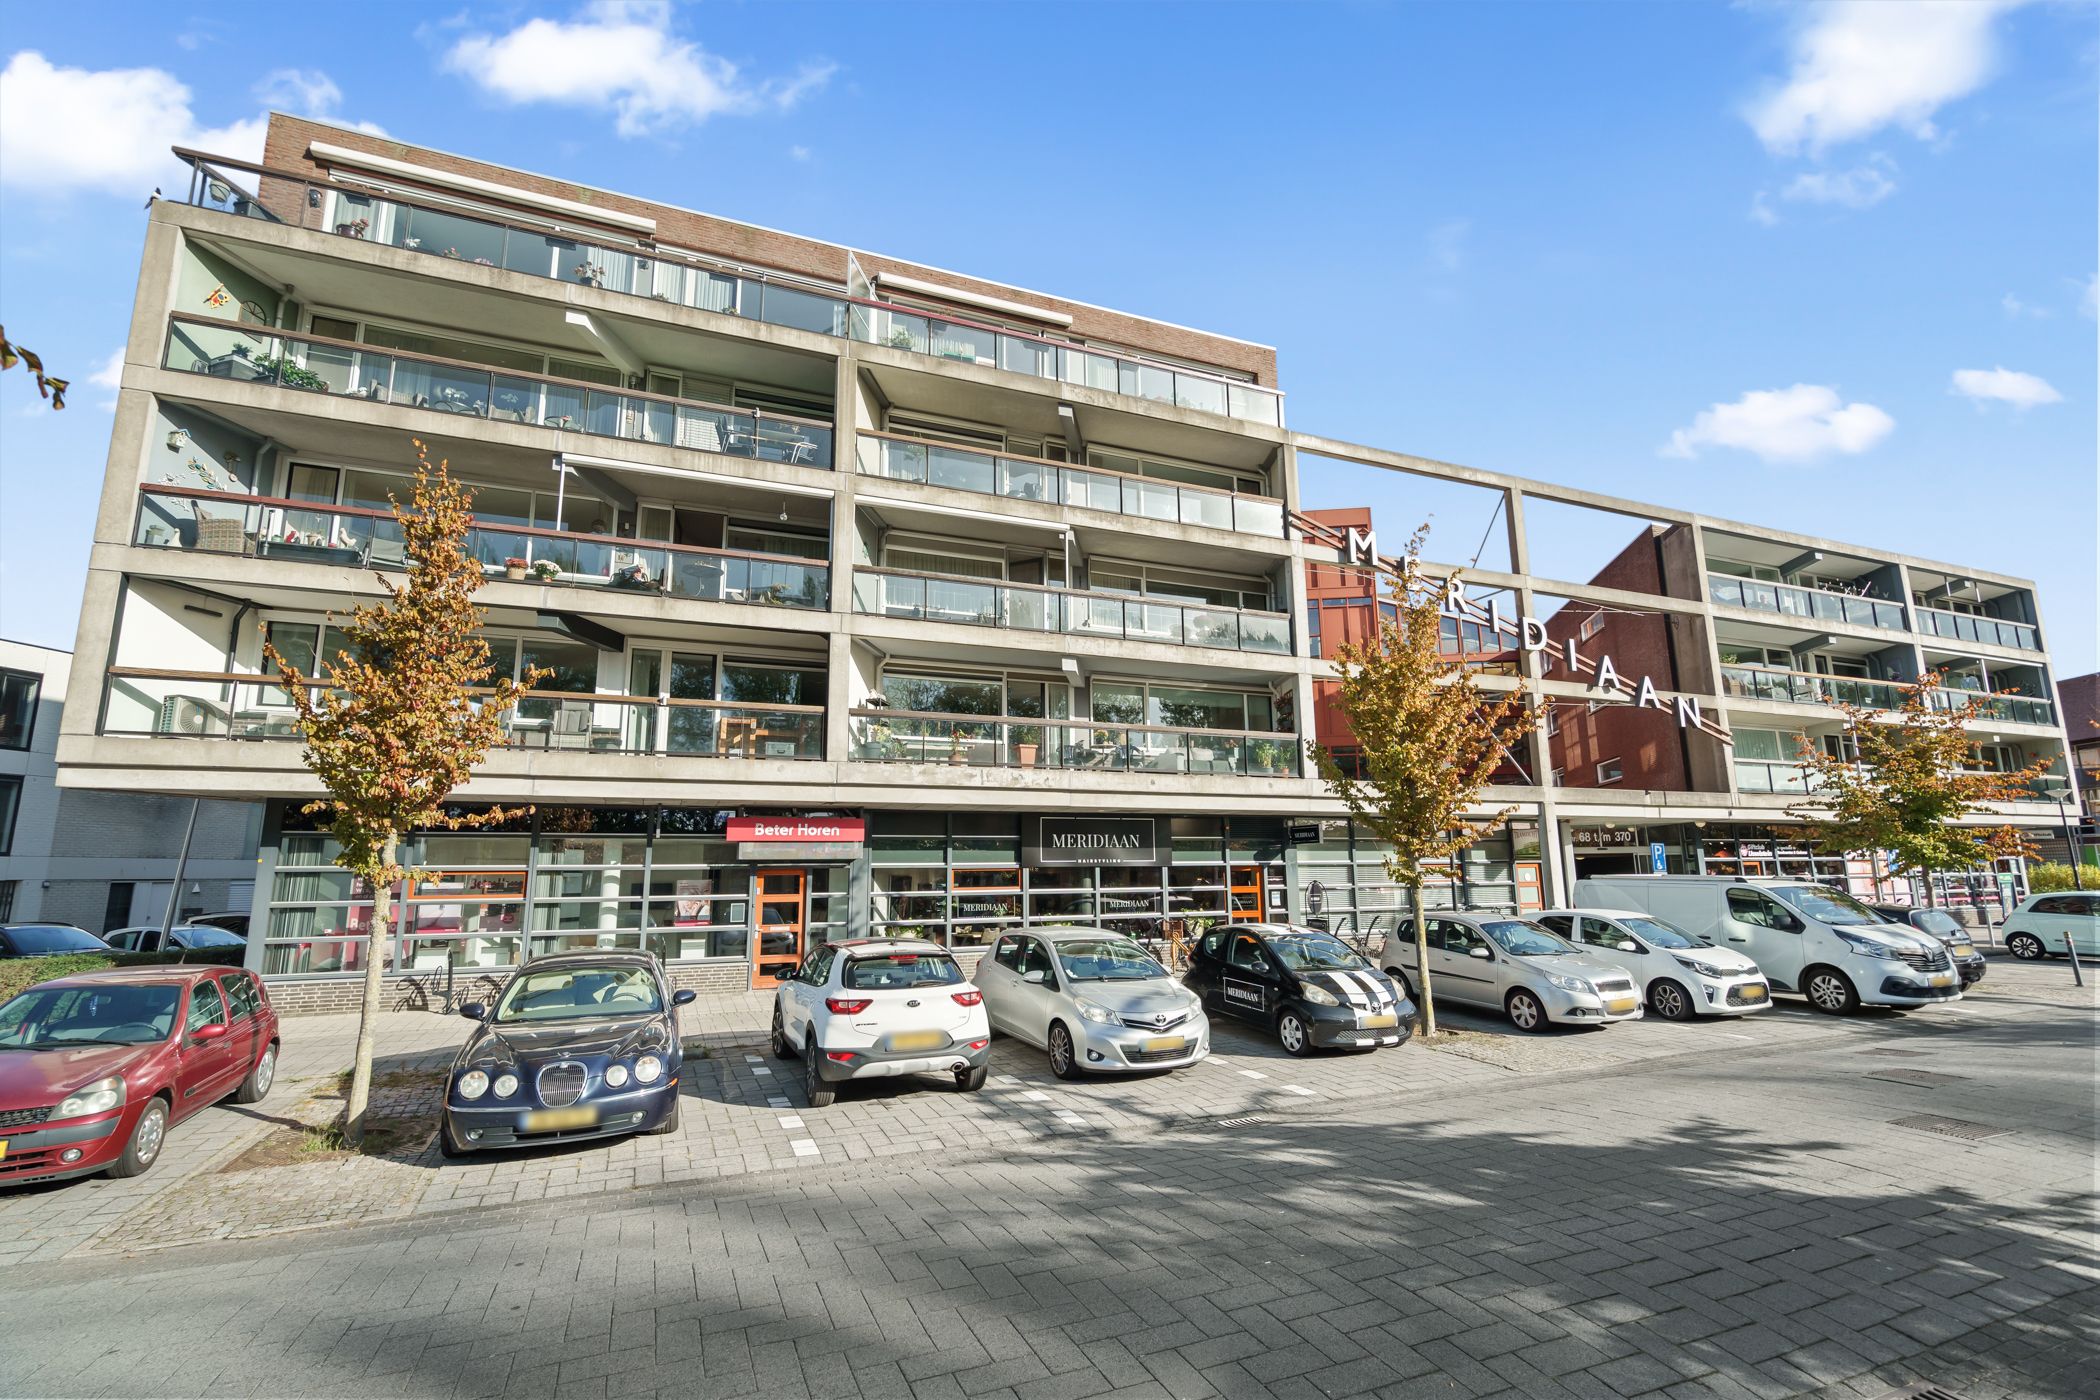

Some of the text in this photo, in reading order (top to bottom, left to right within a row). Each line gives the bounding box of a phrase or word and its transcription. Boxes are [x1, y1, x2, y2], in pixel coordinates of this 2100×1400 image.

[1348, 527, 1702, 729] MERIDIAAN
[755, 823, 840, 836] Beter Horen
[1052, 833, 1140, 848] MERIDIAAN
[1579, 832, 1591, 842] 68
[1614, 831, 1632, 842] 370
[1654, 845, 1662, 859] P
[963, 903, 1008, 912] MERIDIAAN
[1109, 899, 1150, 908] MERIDIAAN
[1227, 986, 1258, 1002] MERIDIAAN
